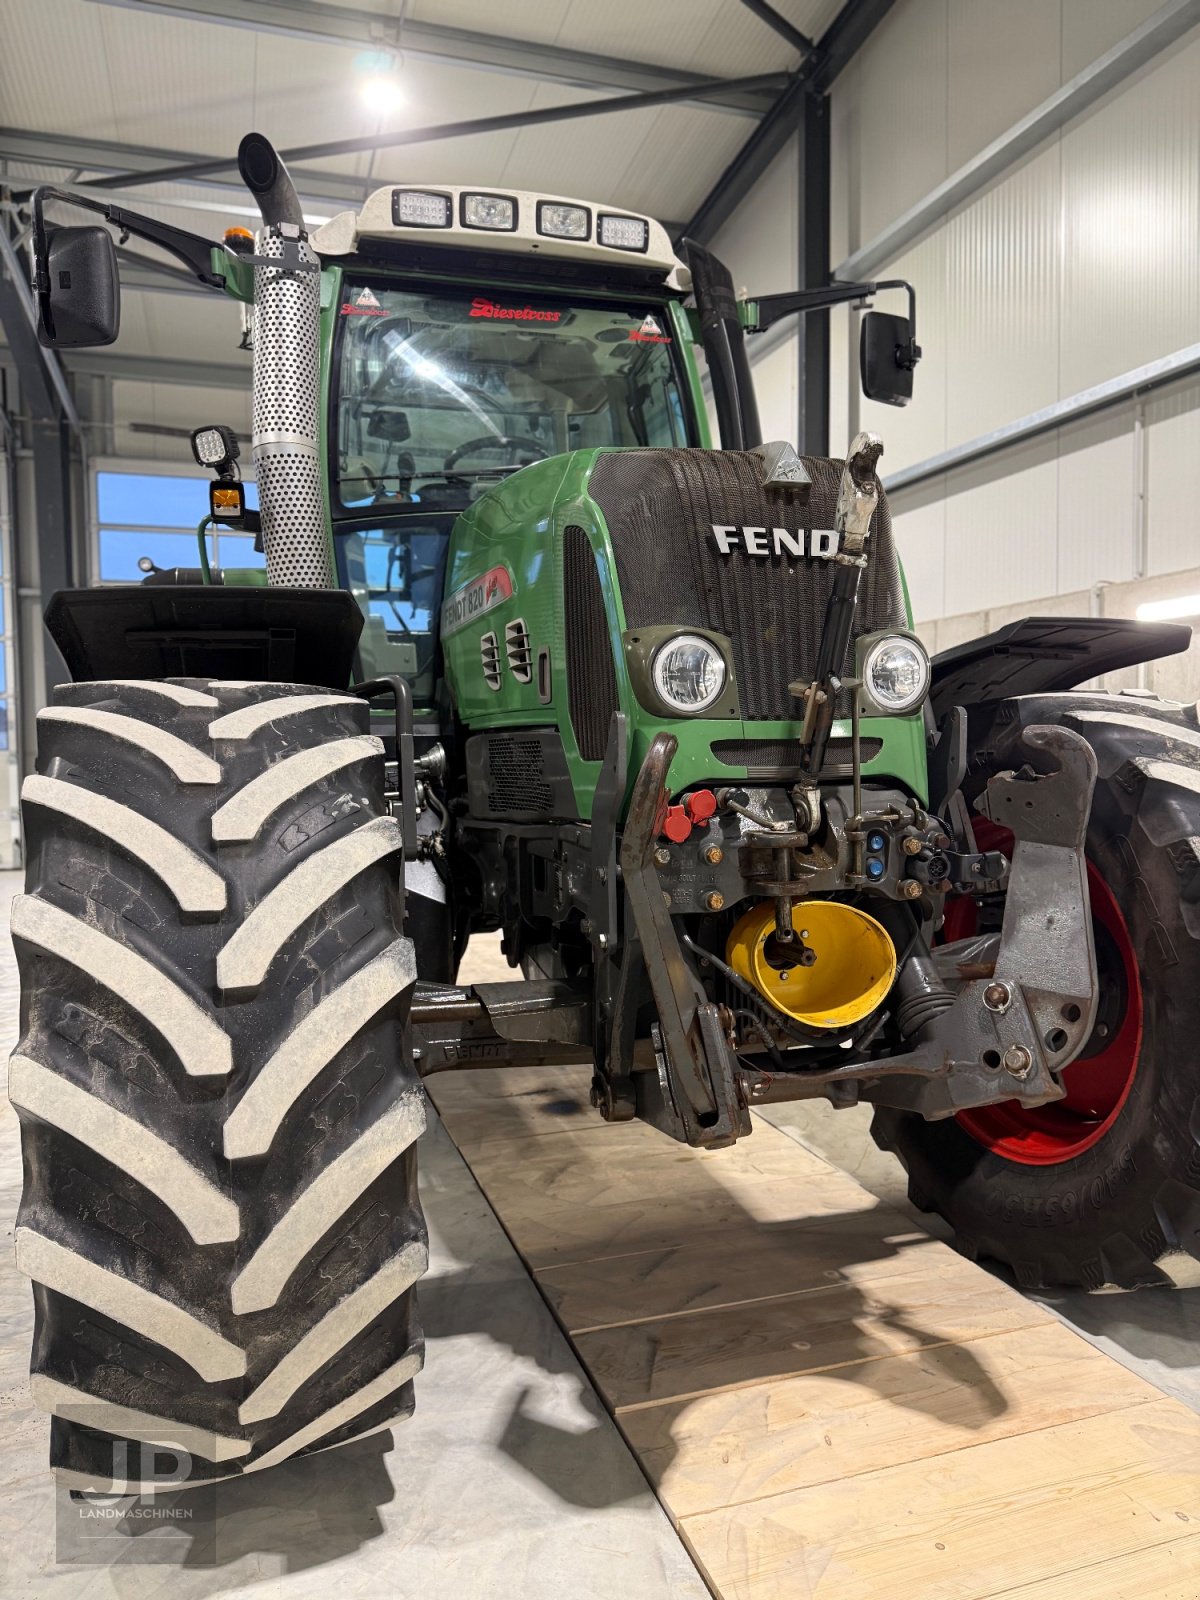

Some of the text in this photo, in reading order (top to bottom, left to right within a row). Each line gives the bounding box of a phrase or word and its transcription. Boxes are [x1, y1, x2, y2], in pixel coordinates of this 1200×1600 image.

[469, 297, 561, 321] Dieselross
[711, 525, 870, 556] FEND
[444, 596, 466, 628] FENDT
[468, 585, 484, 614] 820
